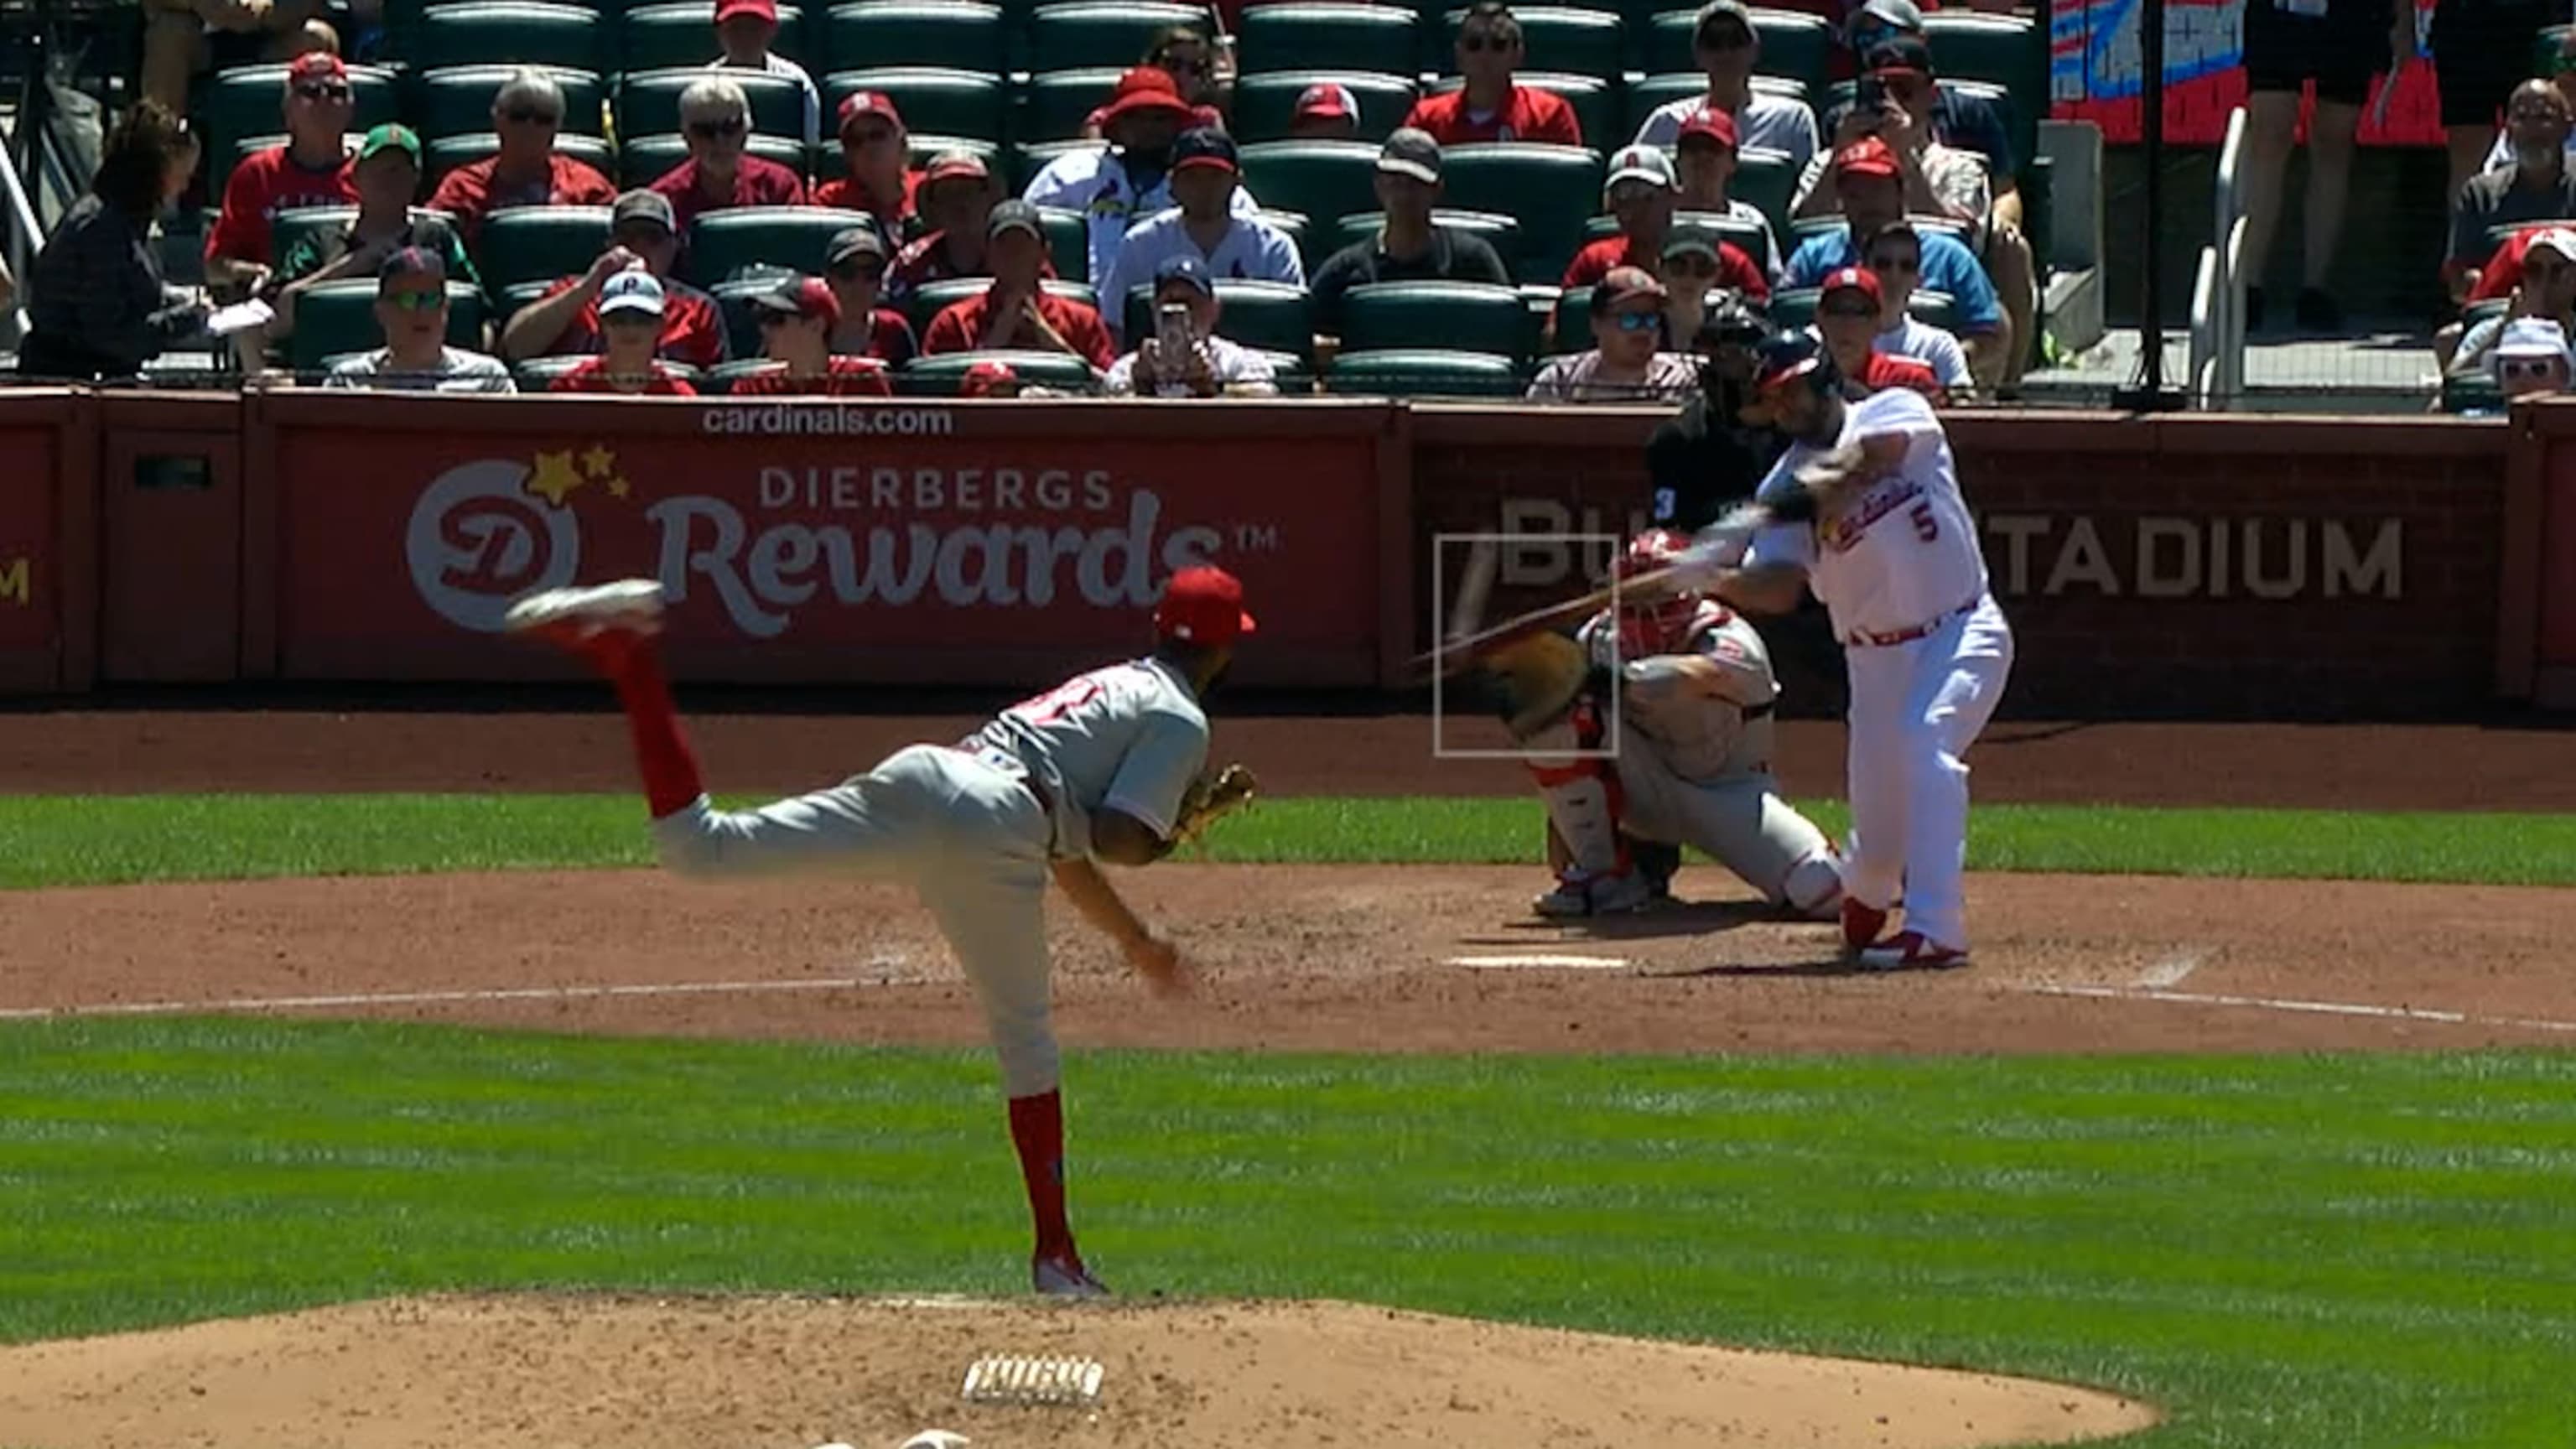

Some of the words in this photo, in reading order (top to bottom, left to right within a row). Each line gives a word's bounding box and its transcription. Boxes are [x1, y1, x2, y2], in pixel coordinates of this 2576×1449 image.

[703, 405, 953, 435] cardinals.com
[760, 469, 1111, 509] DIERBERGS
[1910, 504, 1939, 543] 5
[646, 490, 1222, 637] Rewards
[1988, 516, 2402, 599] TADIUM
